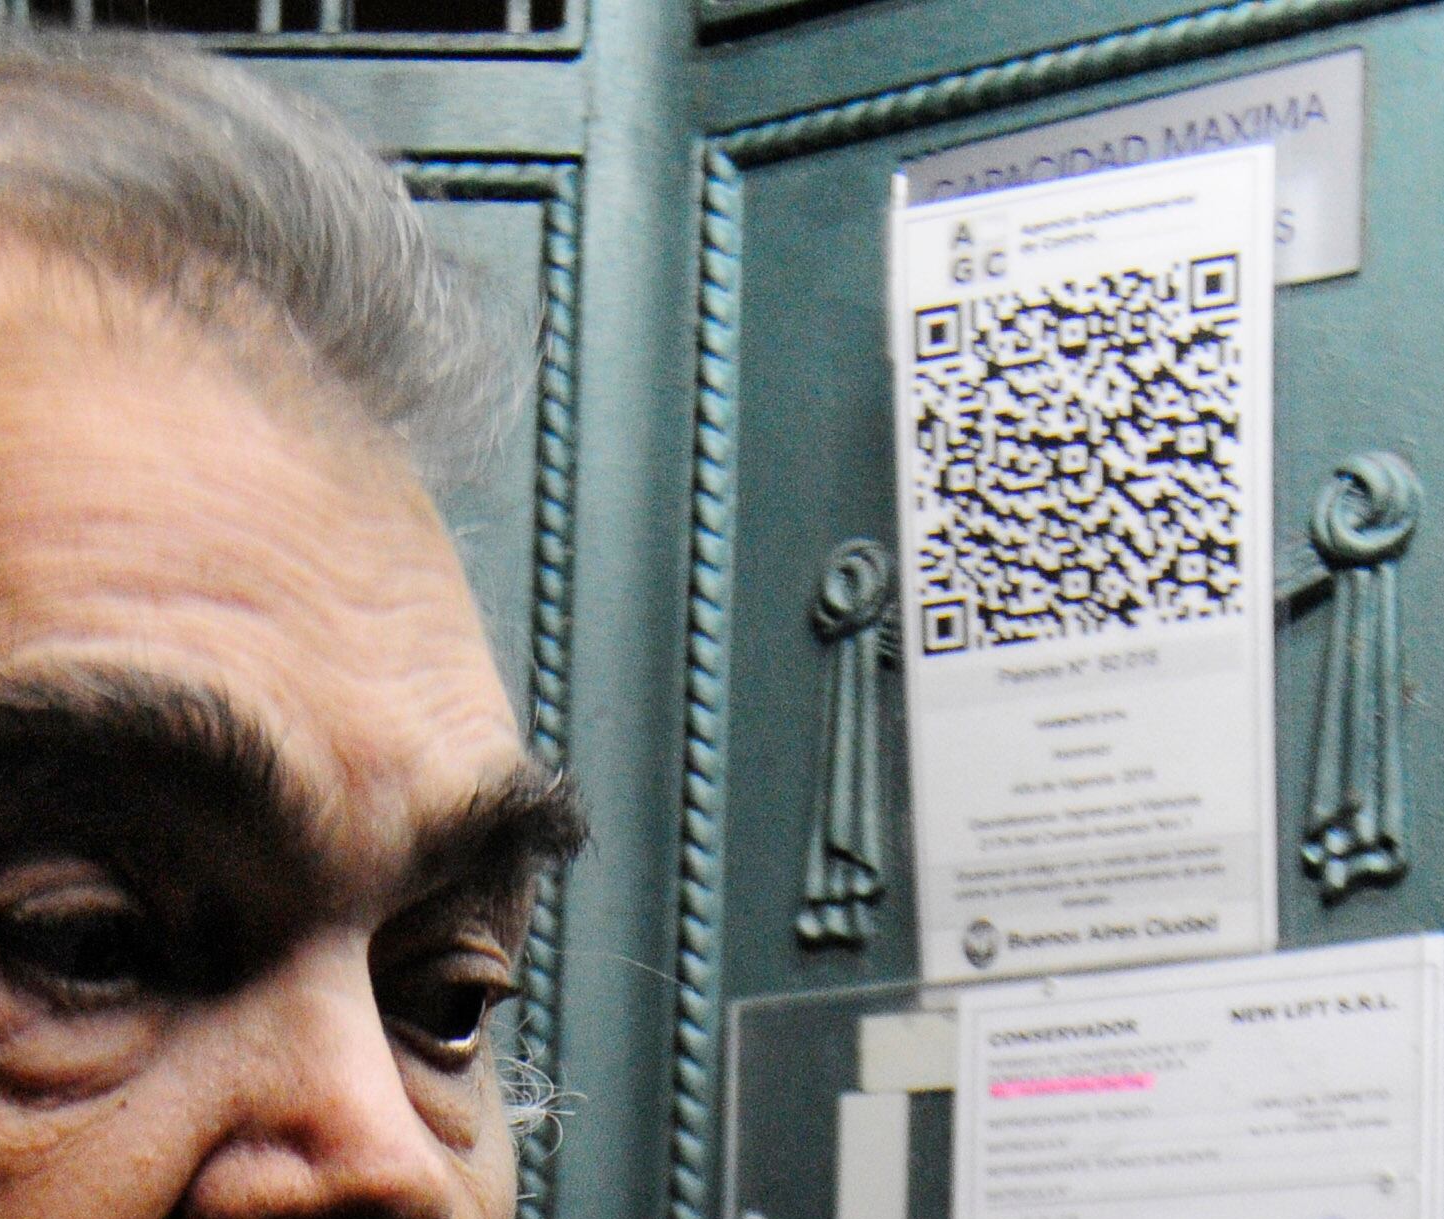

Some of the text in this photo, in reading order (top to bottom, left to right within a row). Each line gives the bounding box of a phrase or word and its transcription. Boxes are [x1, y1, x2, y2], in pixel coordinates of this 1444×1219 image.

[951, 220, 974, 248] A
[951, 250, 1007, 284] G C
[1006, 913, 1219, 951] Buenos Aires Ciudad
[1229, 1004, 1276, 1025] NEW
[1283, 998, 1329, 1019] LIFT
[987, 1018, 1140, 1047] CONSERVADOR
